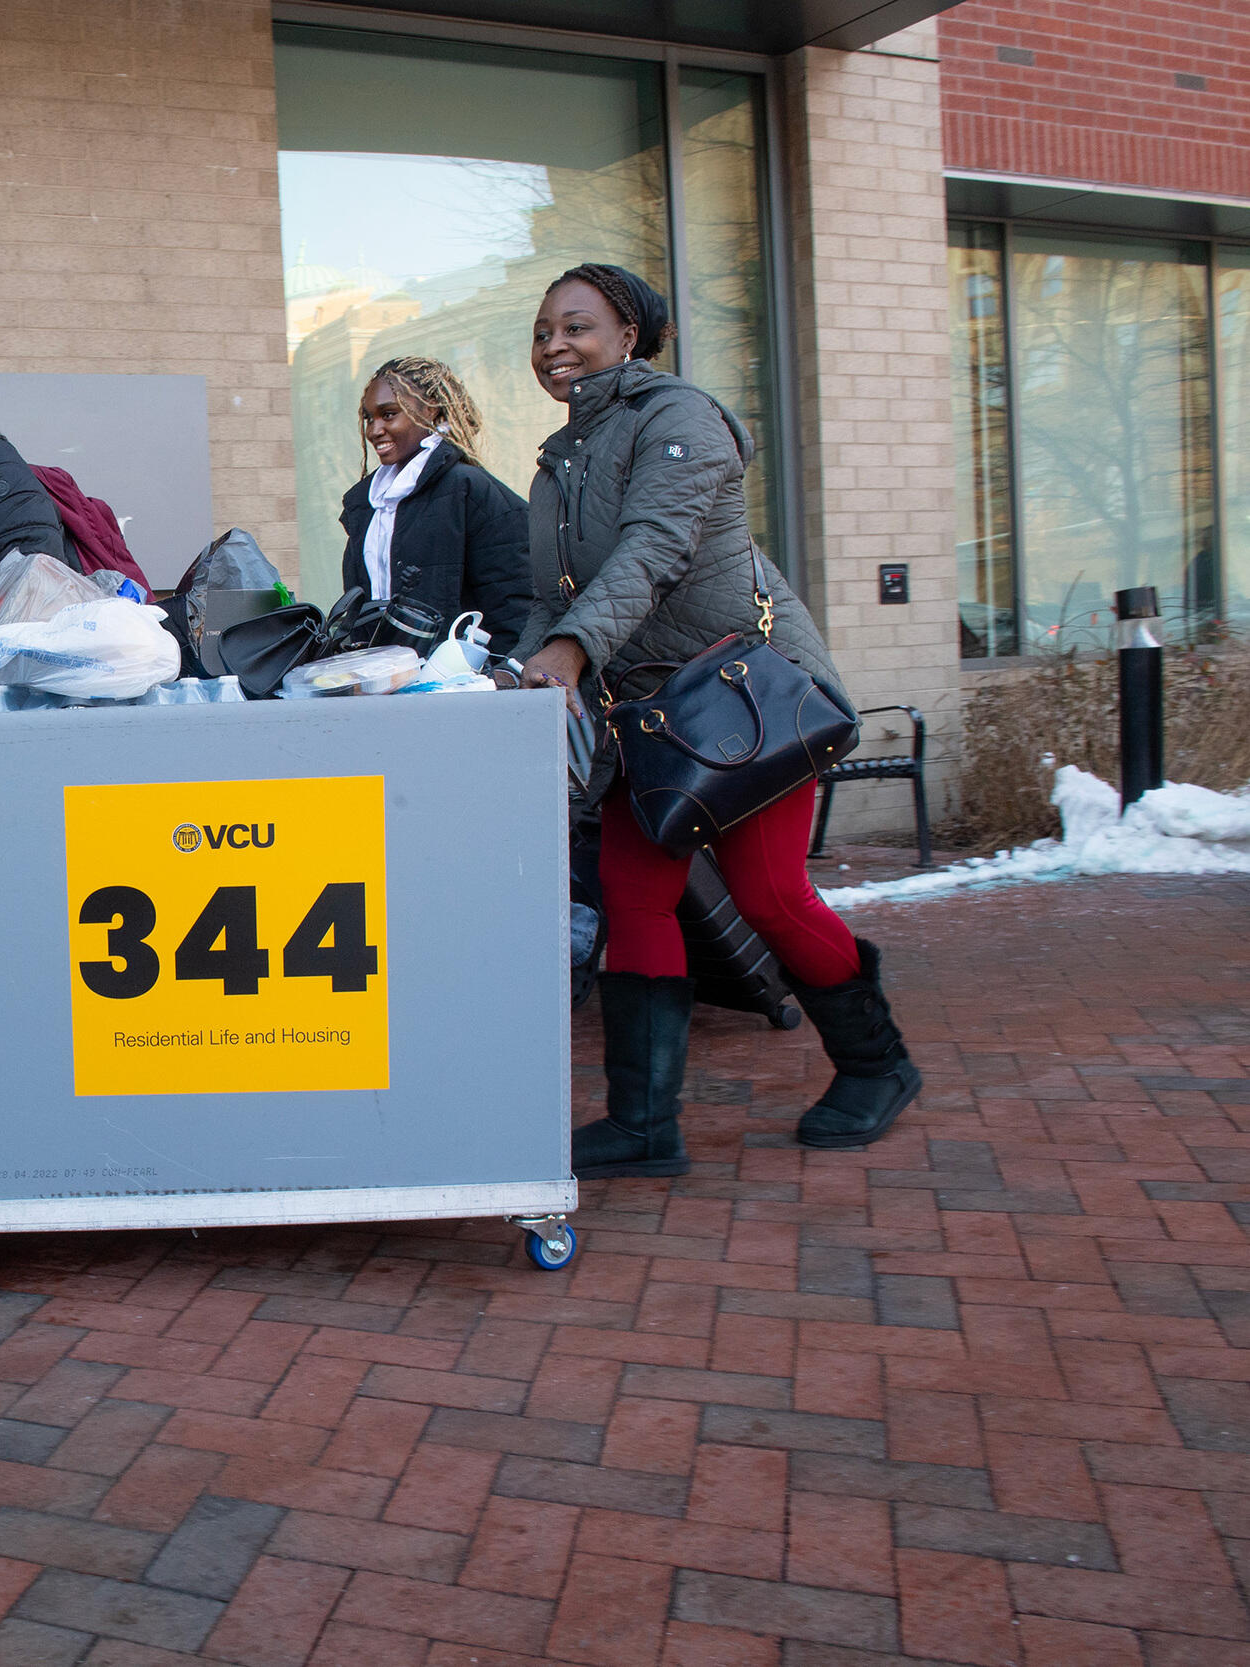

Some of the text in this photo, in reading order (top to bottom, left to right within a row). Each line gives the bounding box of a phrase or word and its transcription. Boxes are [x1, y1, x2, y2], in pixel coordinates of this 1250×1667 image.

[202, 823, 275, 850] VCU
[78, 881, 378, 999] 344
[114, 1027, 351, 1048] Residential Life and Housing
